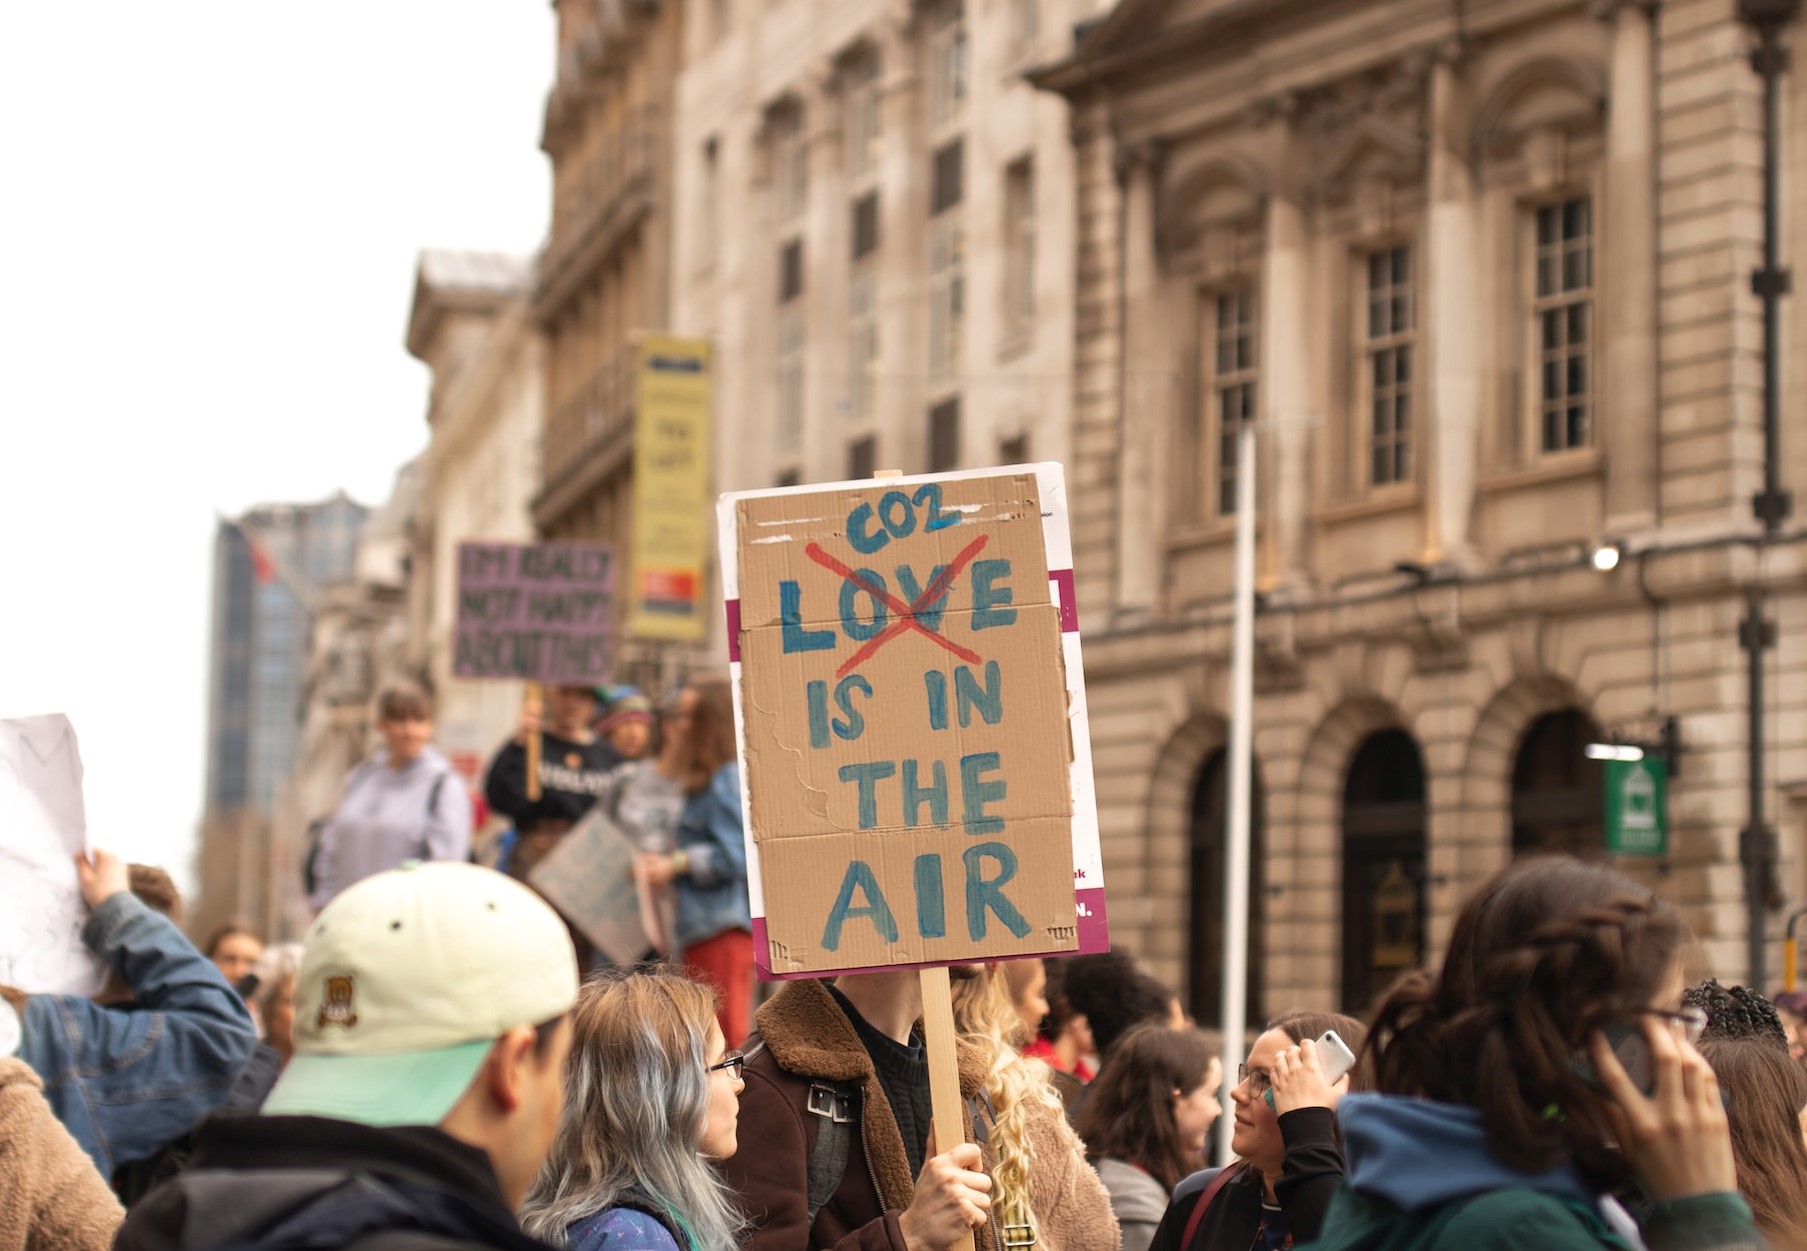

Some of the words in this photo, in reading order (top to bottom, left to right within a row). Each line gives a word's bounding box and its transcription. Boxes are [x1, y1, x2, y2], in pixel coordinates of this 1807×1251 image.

[846, 484, 961, 554] CO2
[460, 587, 521, 622] NOT
[779, 559, 1017, 654] LOVE
[806, 674, 873, 748] IS
[925, 661, 1003, 730] IN
[839, 752, 1007, 835] THE
[821, 842, 1032, 952] AIR
